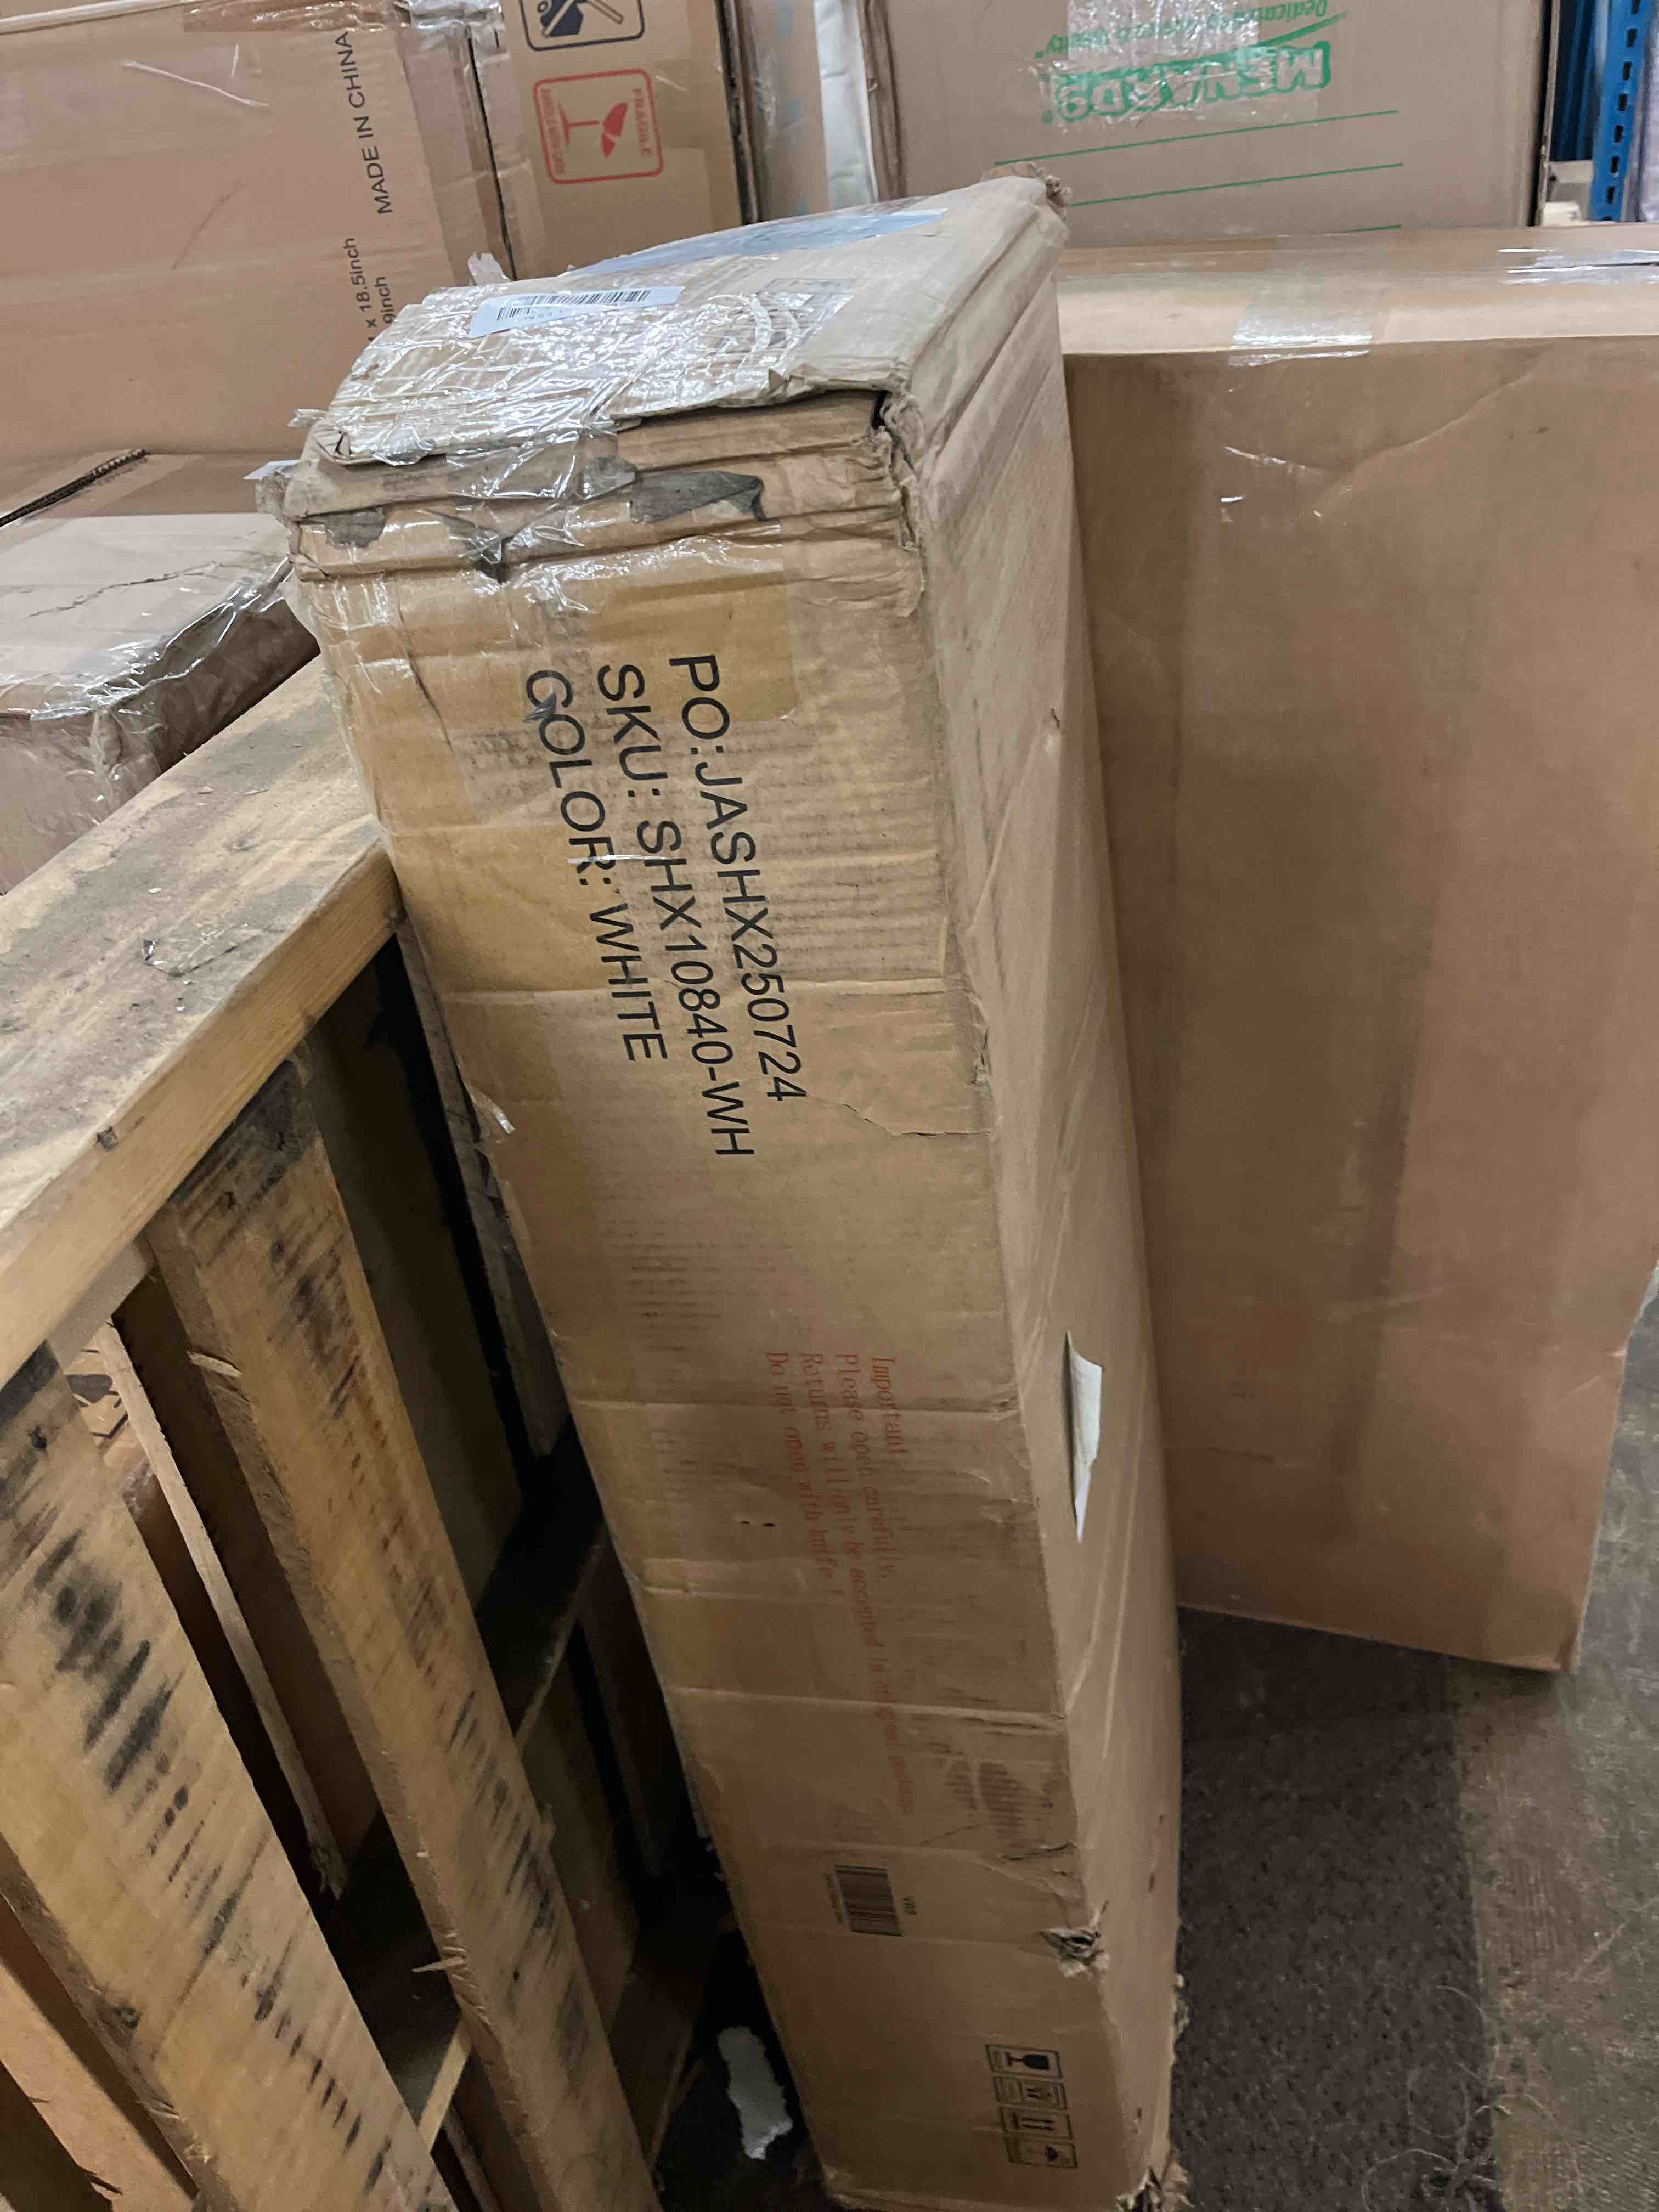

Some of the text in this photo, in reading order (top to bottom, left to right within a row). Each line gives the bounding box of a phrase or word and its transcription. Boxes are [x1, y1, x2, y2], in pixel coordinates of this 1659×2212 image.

[335, 31, 393, 215] MADE IN CHINA
[343, 238, 373, 313] 18.5inch
[366, 318, 378, 329] x
[525, 669, 668, 1062] COLOR: WHITE
[669, 654, 807, 1101] PO:JASHX250724
[597, 664, 755, 1155] SKU: SHX10840-WH
[767, 1352, 790, 1375] Do
[772, 1386, 798, 1415] not
[800, 1353, 832, 1431] Returns
[835, 1354, 864, 1420] Please
[870, 1356, 909, 1454] Important
[782, 1426, 808, 1472] open
